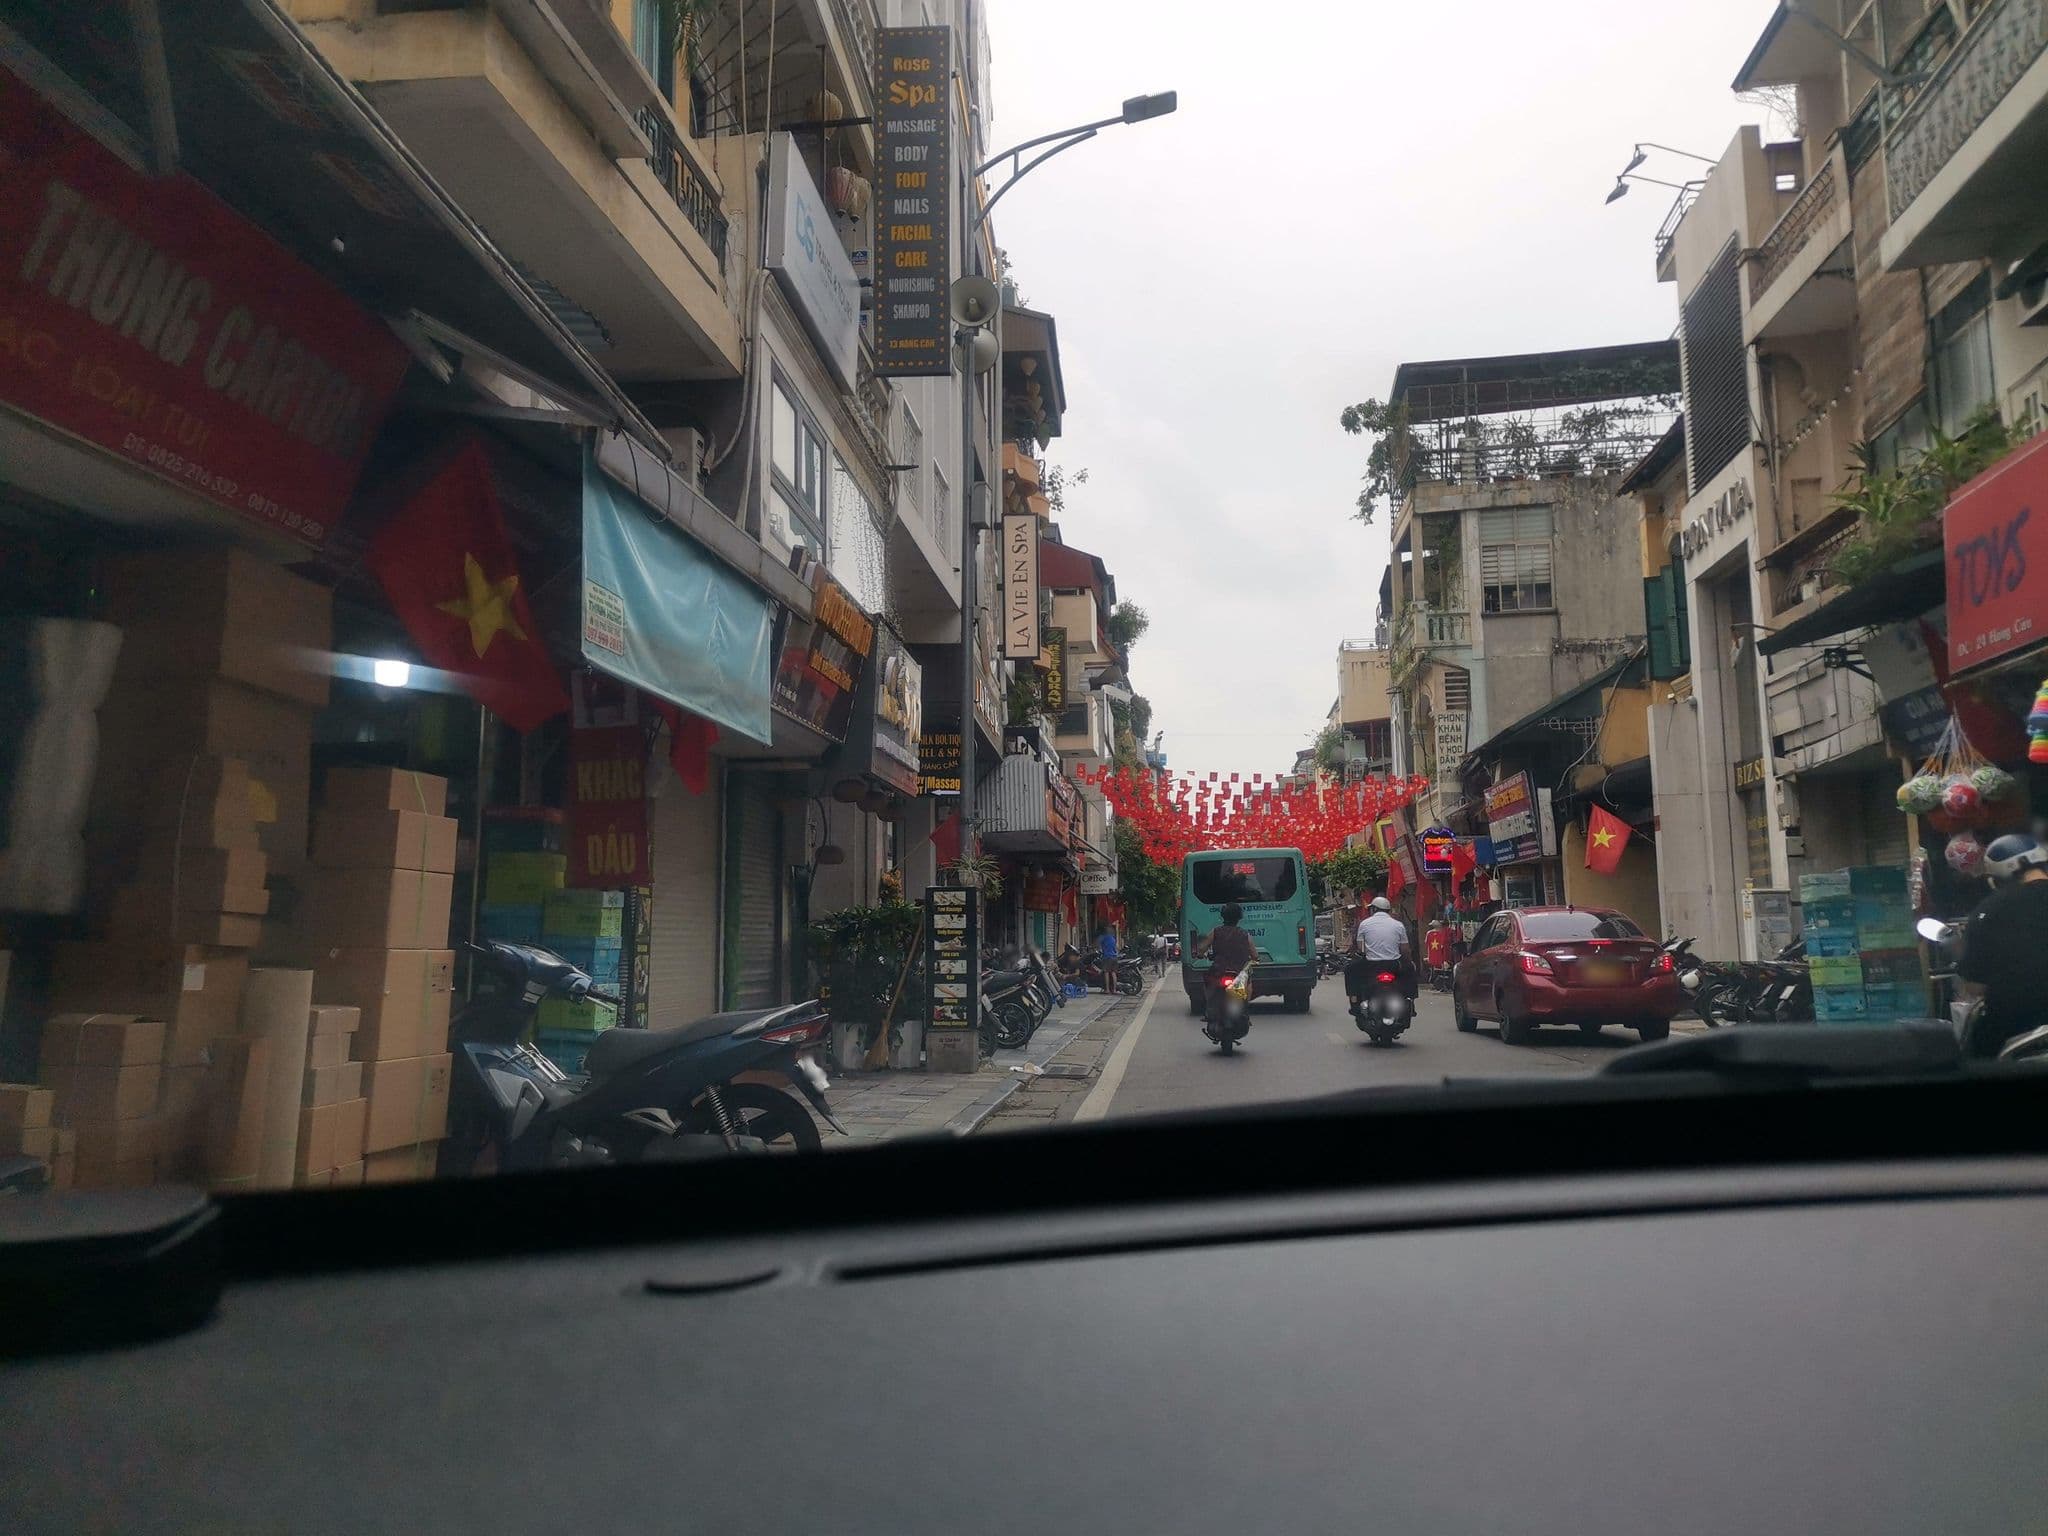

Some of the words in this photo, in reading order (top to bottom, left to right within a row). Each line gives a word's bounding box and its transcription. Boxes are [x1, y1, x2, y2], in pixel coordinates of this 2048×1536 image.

[893, 58, 931, 72] Rose
[889, 79, 937, 108] Spa
[887, 119, 937, 133] MASSAGE
[894, 145, 929, 162] BODY
[895, 172, 928, 189] FOOT
[894, 199, 930, 214] NAILS
[890, 224, 933, 241] FACIAL
[895, 252, 929, 268] CARE
[888, 278, 936, 293] NOURISHING
[892, 304, 931, 319] SHAMPOO
[1011, 522, 1028, 555] SPA
[1012, 560, 1029, 585] EN
[1012, 590, 1029, 623] VIE
[1013, 626, 1030, 649] LA
[938, 749, 945, 758] &
[1081, 874, 1107, 883] Coffee
